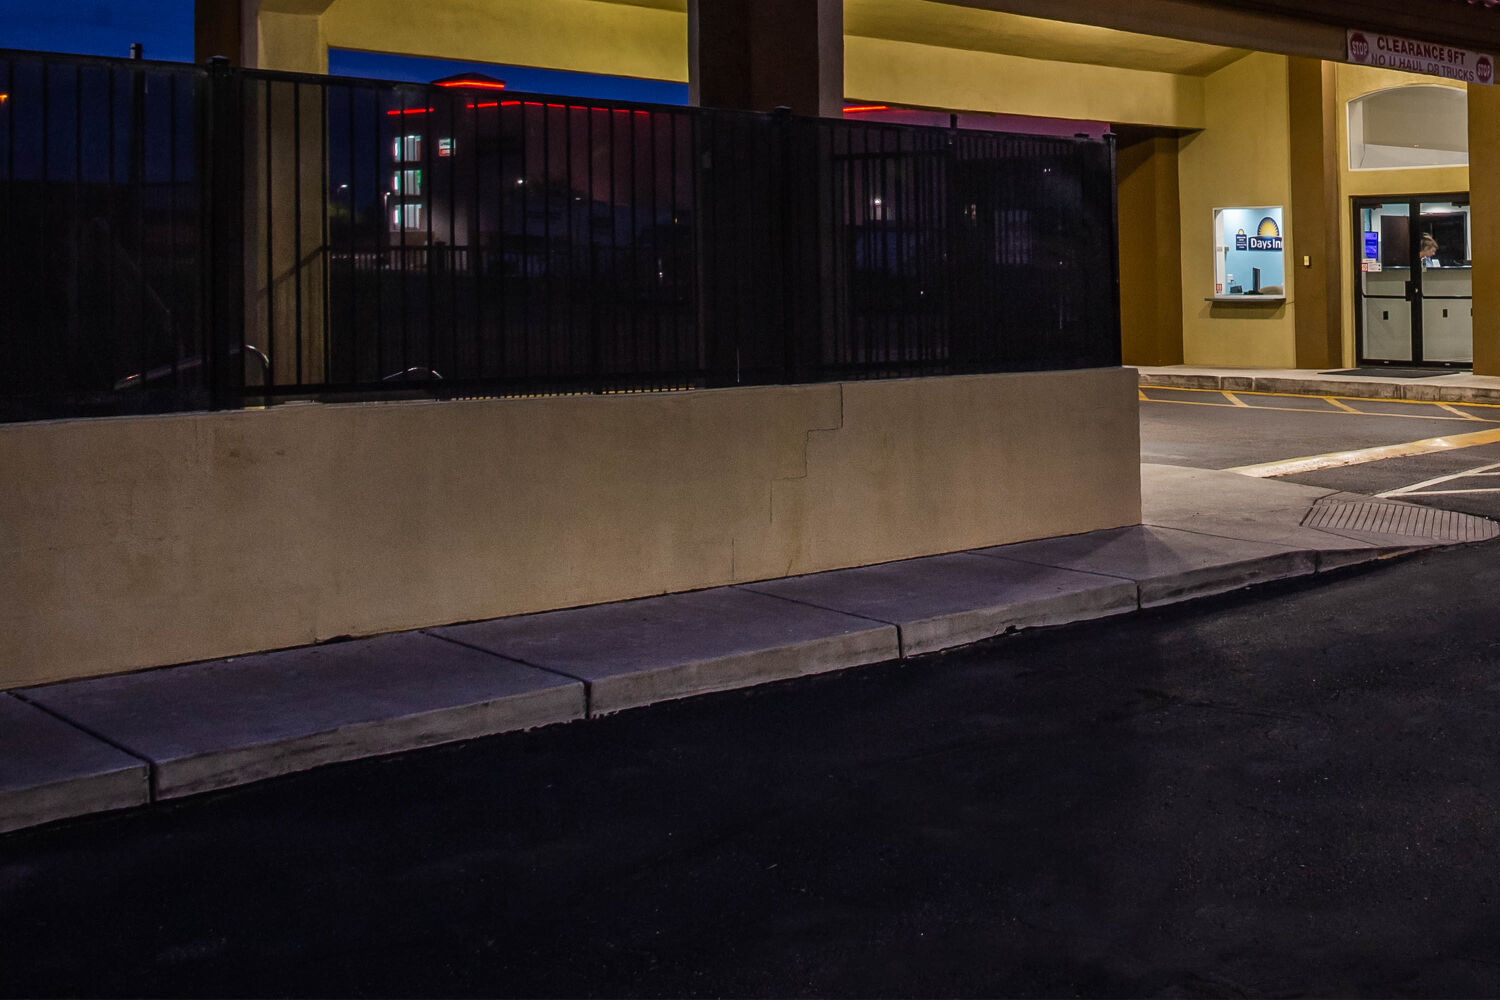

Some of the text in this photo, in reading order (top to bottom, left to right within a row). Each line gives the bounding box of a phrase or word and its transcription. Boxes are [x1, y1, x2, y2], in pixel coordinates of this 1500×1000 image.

[1352, 40, 1369, 55] STOP
[1377, 37, 1466, 65] CLEARANCE 9FT
[1371, 54, 1386, 66] NO
[1399, 58, 1424, 72] HAUL
[1441, 65, 1475, 81] TRUCKS
[1478, 62, 1491, 77] STOP
[1250, 238, 1272, 249] Days
